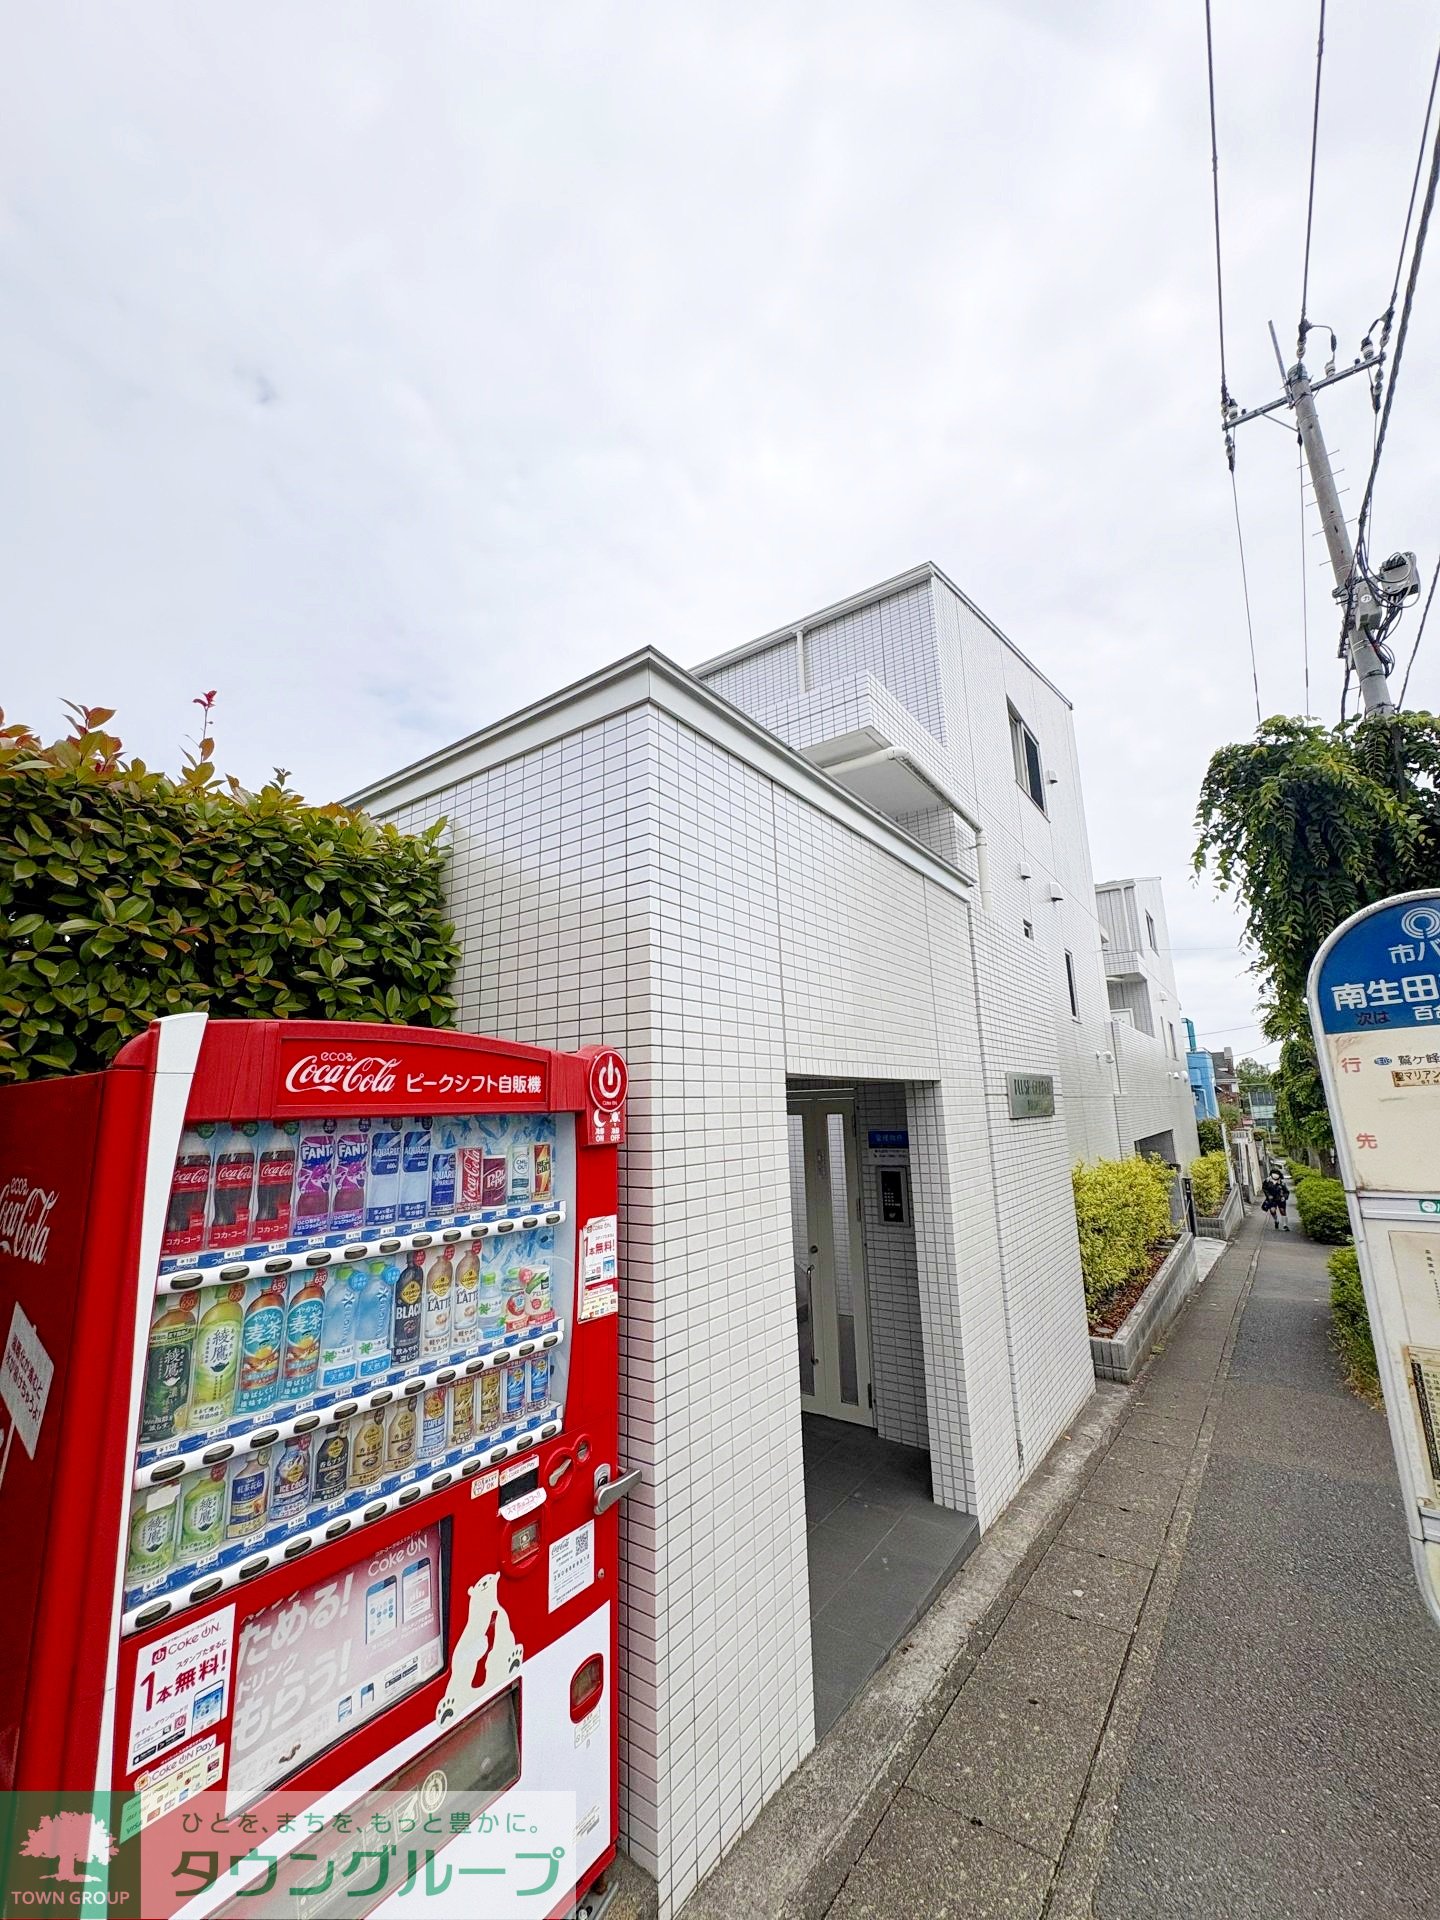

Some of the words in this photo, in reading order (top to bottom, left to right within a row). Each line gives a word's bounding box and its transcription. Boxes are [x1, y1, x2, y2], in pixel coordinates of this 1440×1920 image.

[1331, 974, 1440, 1011] 南生田
[1356, 1010, 1391, 1026] 次は
[285, 1055, 402, 1093] Coca-Cola
[406, 1073, 542, 1094] ピークシフト自販機
[584, 1237, 615, 1258] 1本無料!
[272, 1282, 286, 1291] 650
[315, 1275, 327, 1283] 650
[289, 1308, 322, 1335] 麦茶
[396, 1302, 422, 1320] BLAC
[210, 1329, 229, 1364] 綾鷹
[245, 1318, 281, 1344] 麦茶
[330, 1370, 351, 1382] 天然水
[486, 1482, 495, 1490] OK
[367, 1549, 405, 1577] Coke
[406, 1534, 428, 1557] ON
[238, 1572, 354, 1668] ためる!
[168, 1633, 199, 1656] Coke
[201, 1622, 221, 1639] ON
[175, 1638, 228, 1671] スタンプたまると
[140, 1648, 227, 1713] 1本無料!
[238, 1653, 298, 1697] ドリンク
[234, 1639, 354, 1752] もらう!
[151, 1760, 177, 1781] Coke
[178, 1750, 194, 1765] ON
[195, 1737, 216, 1754] Pay
